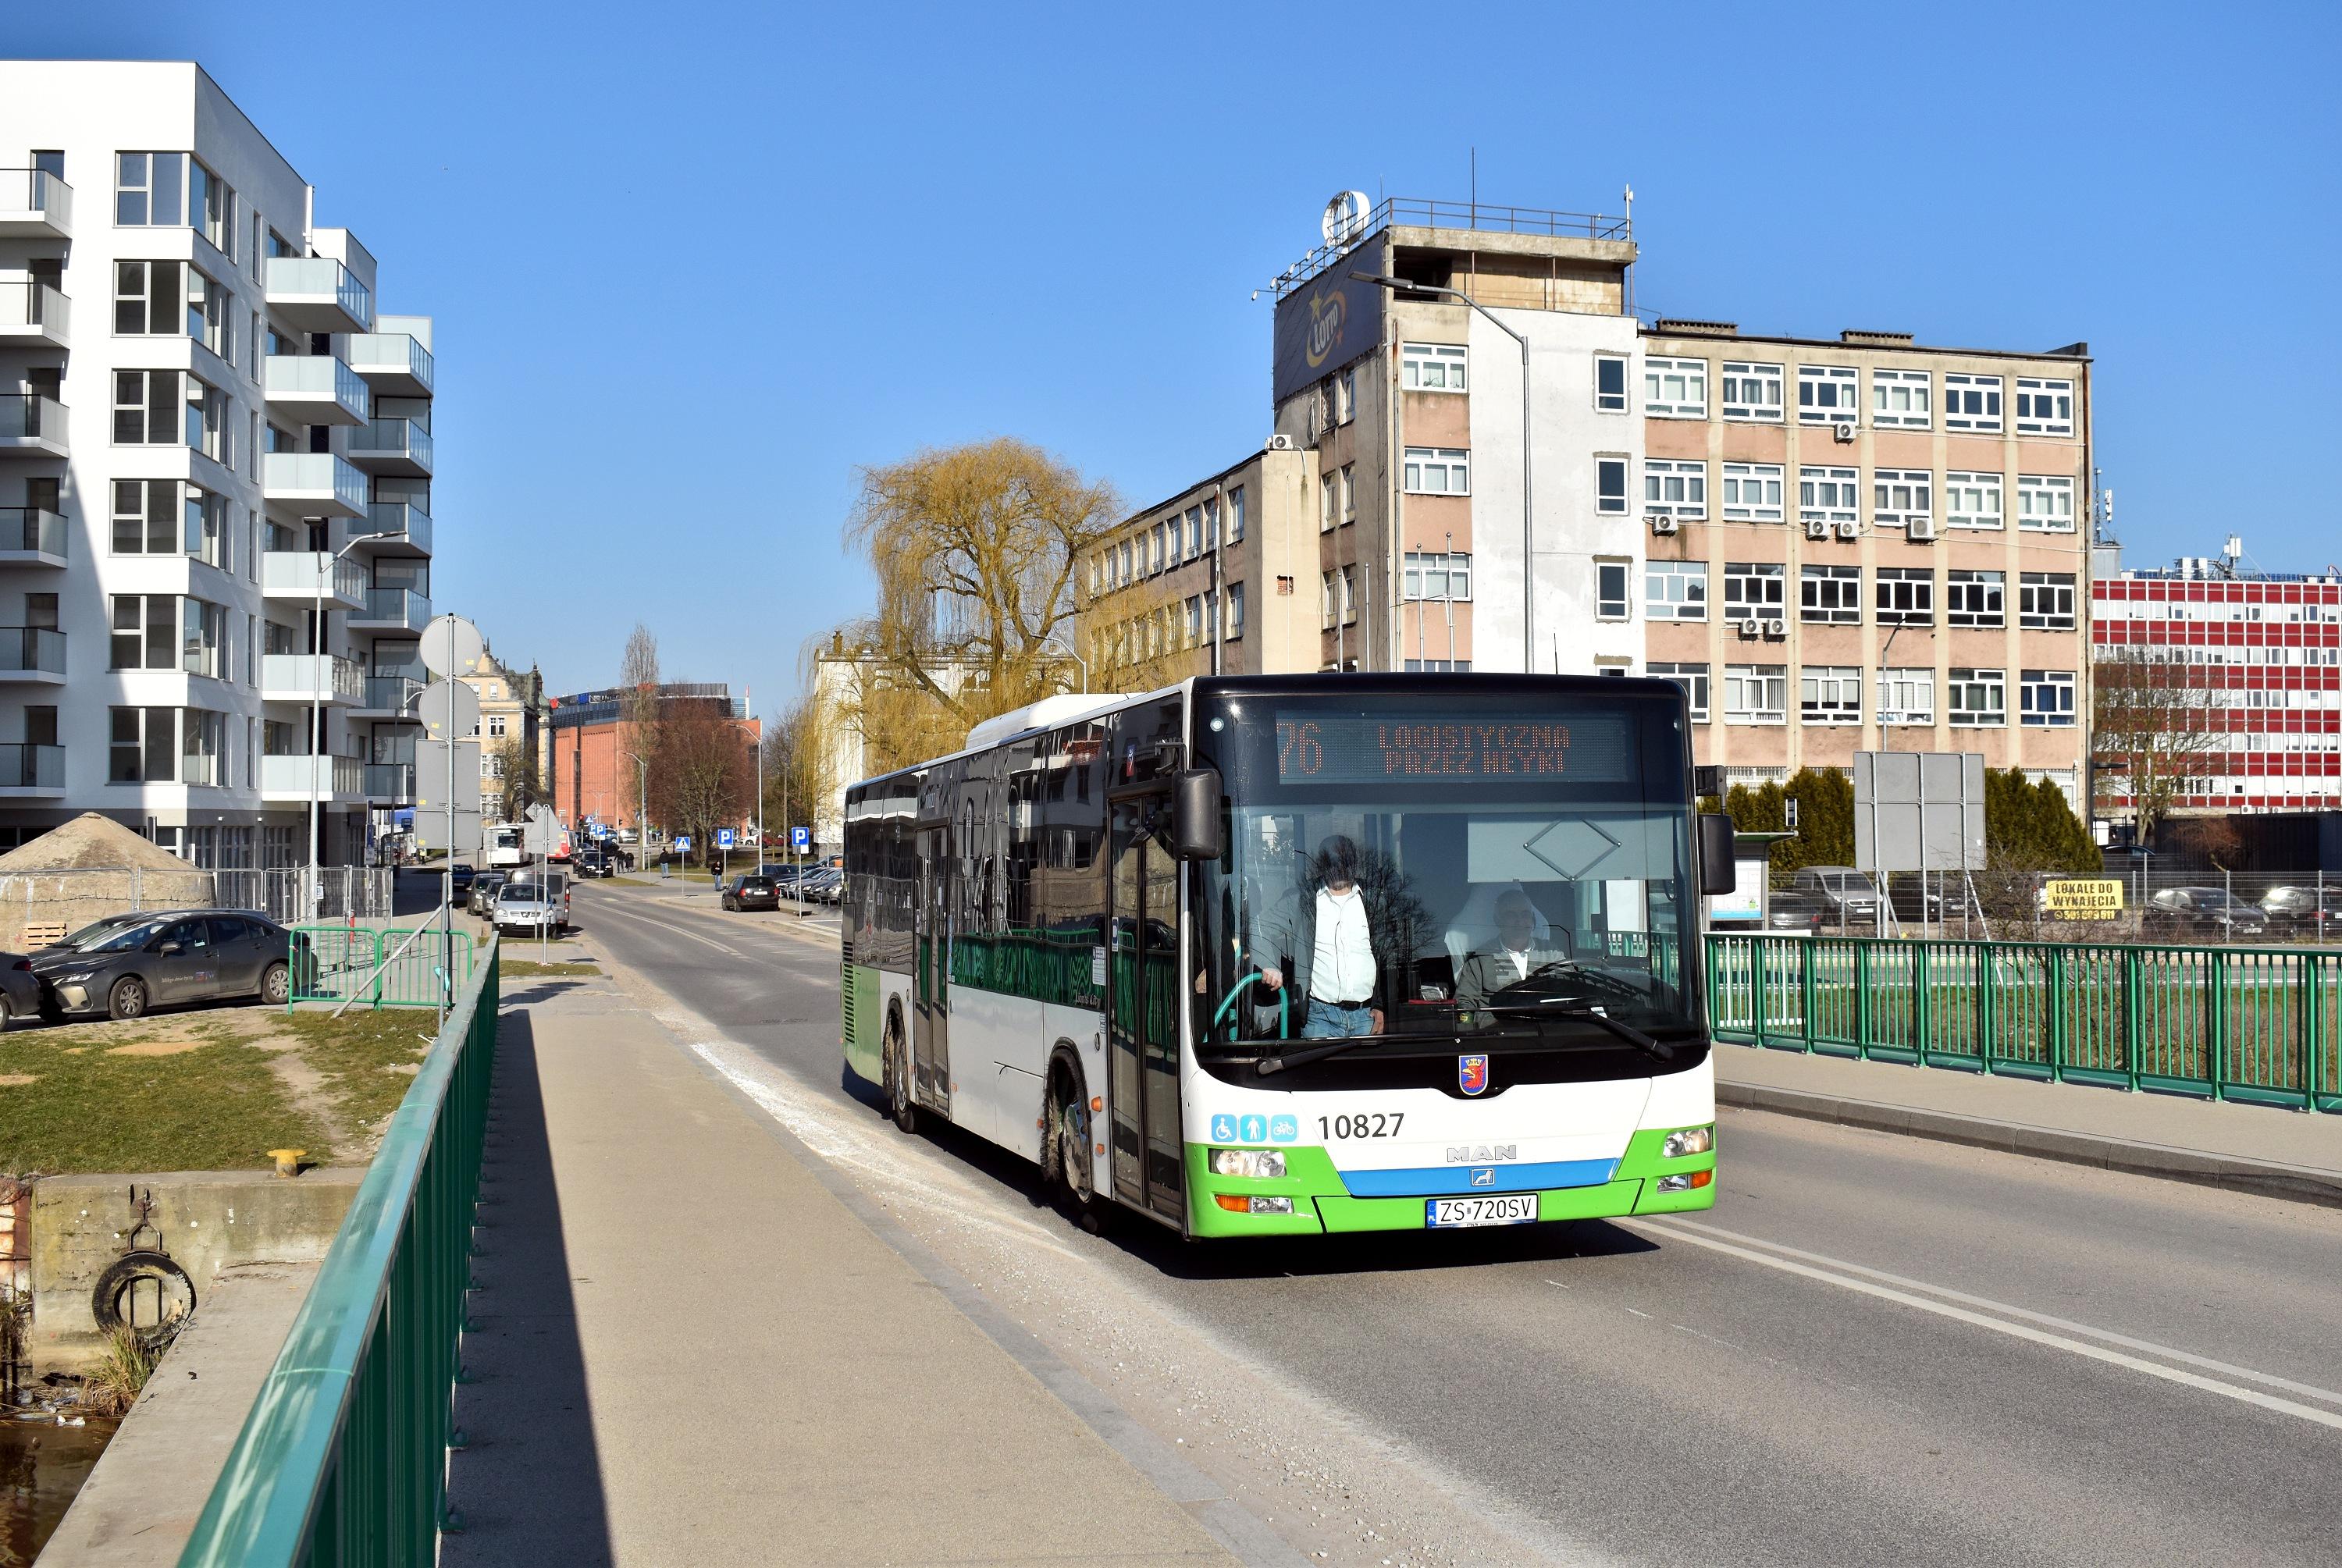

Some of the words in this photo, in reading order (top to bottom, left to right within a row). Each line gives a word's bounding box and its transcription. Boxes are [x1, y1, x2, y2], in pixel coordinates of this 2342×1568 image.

[1314, 303, 1338, 354] LOTTO
[1379, 726, 1570, 748] LOGISTYCZNA
[1276, 723, 1322, 774] 76
[1386, 751, 1474, 773] PRZEZ
[1483, 751, 1564, 773] HEYKI
[721, 830, 730, 844] P
[795, 829, 806, 844] P
[2055, 883, 2095, 894] LOKALE
[2098, 883, 2112, 894] DO
[1318, 1112, 1404, 1140] 10827
[1447, 1144, 1517, 1163] MAN
[1440, 1202, 1465, 1222] ZS
[1472, 1198, 1532, 1220] 720SV
